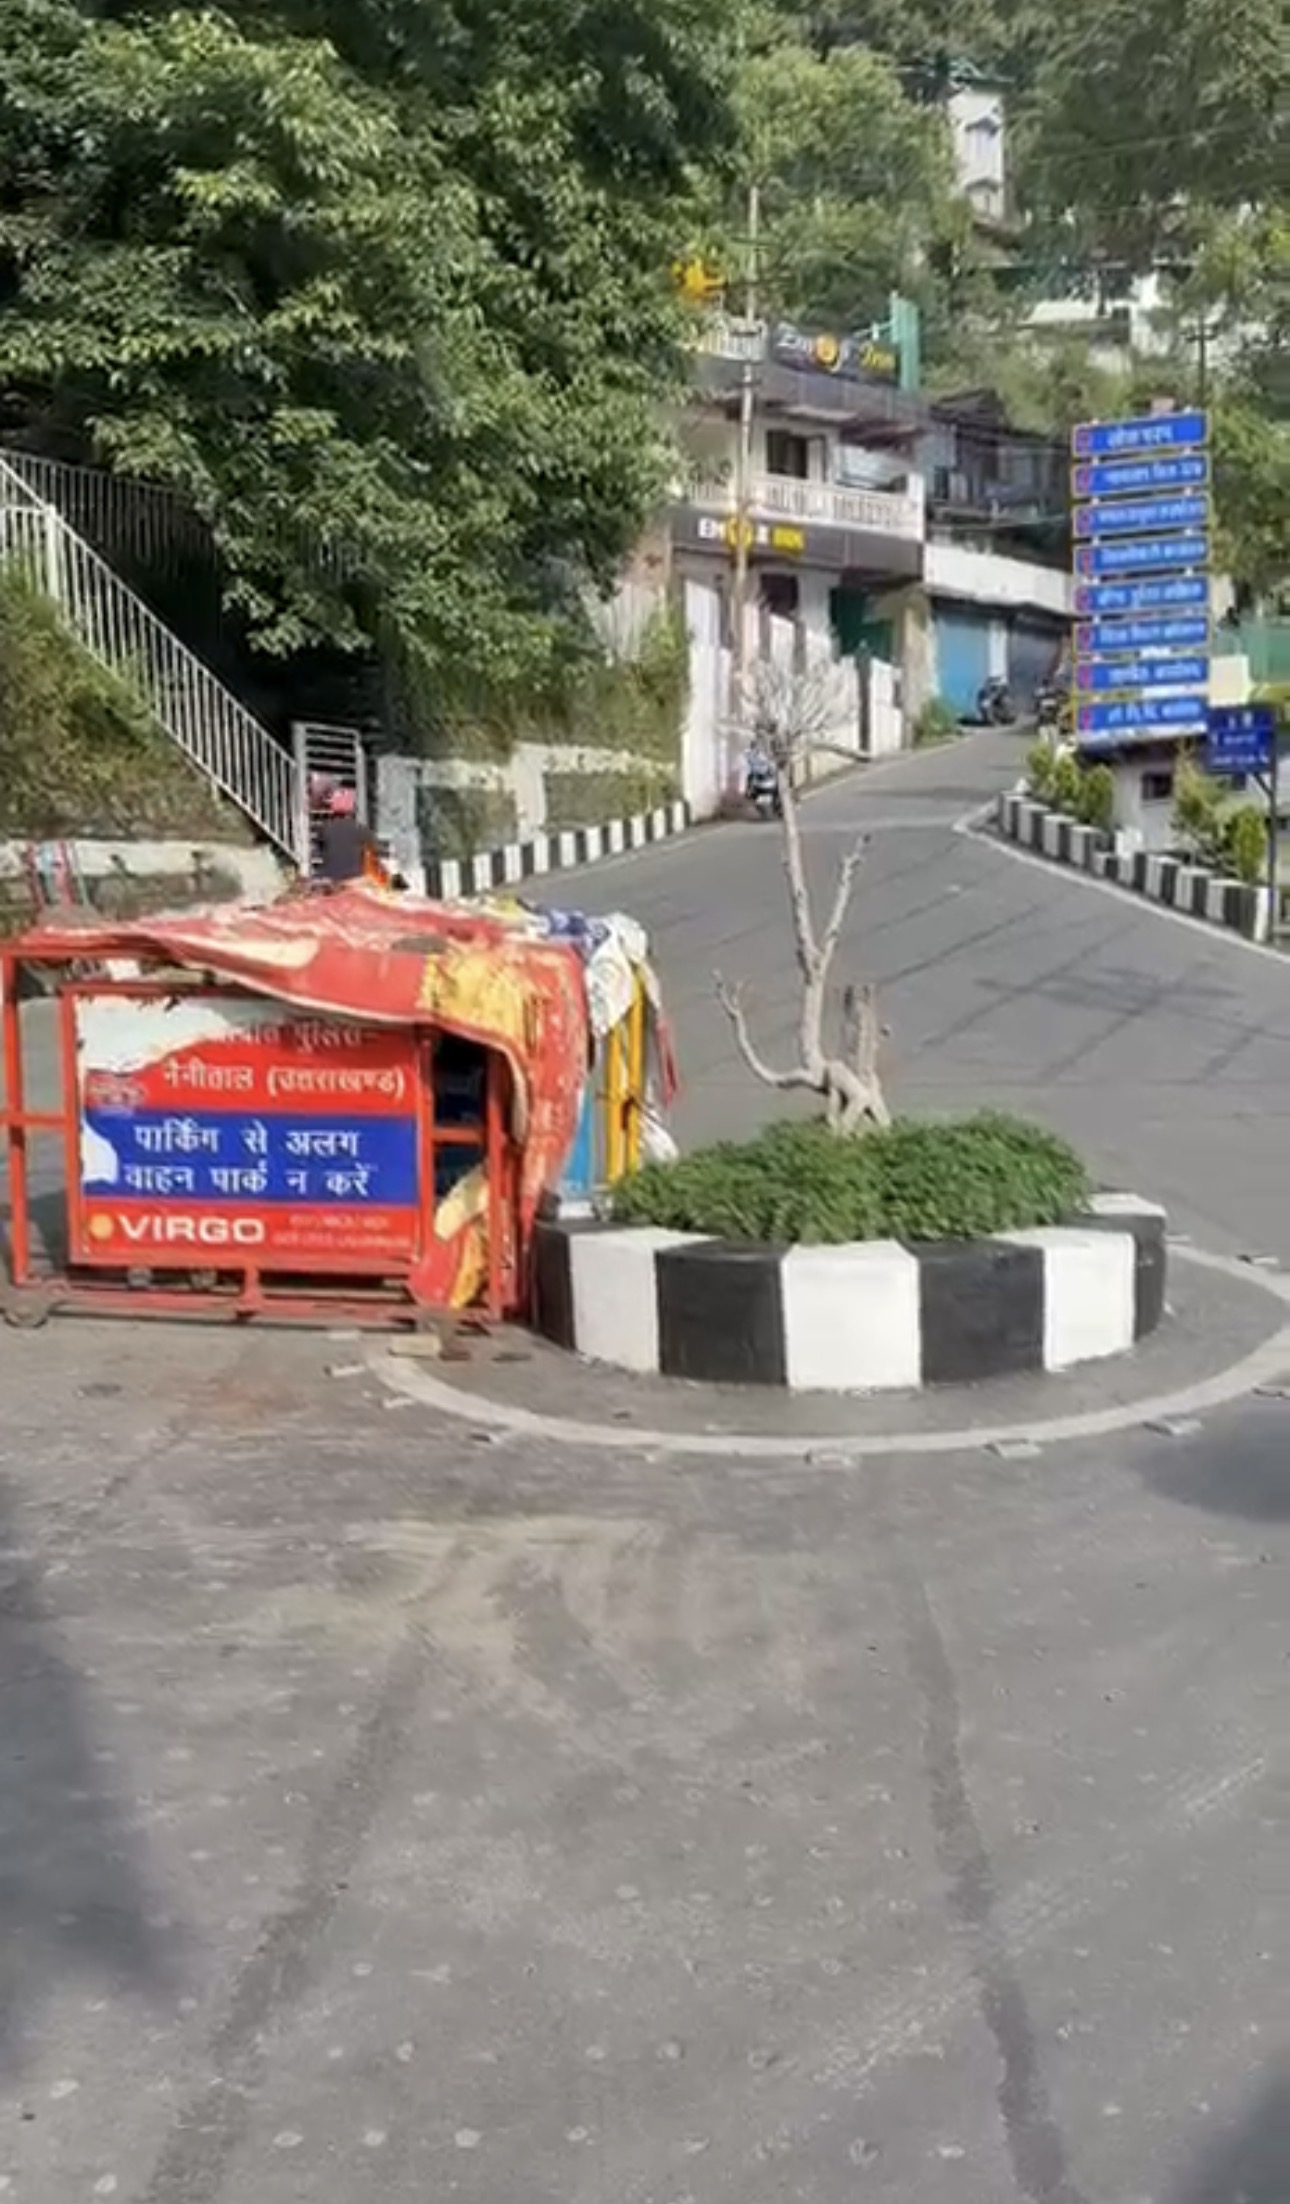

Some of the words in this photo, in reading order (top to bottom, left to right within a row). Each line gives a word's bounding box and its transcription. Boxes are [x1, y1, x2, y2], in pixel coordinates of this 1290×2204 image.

[163, 1055, 254, 1090] नैनीताल
[266, 1065, 405, 1098] (उत्तराखण्ड)
[241, 1118, 268, 1154] से
[286, 1129, 360, 1157] अलग
[123, 1163, 195, 1194] वाहन
[208, 1158, 268, 1193] पार्क
[285, 1168, 308, 1195] न
[118, 1213, 266, 1244] VIRGO
